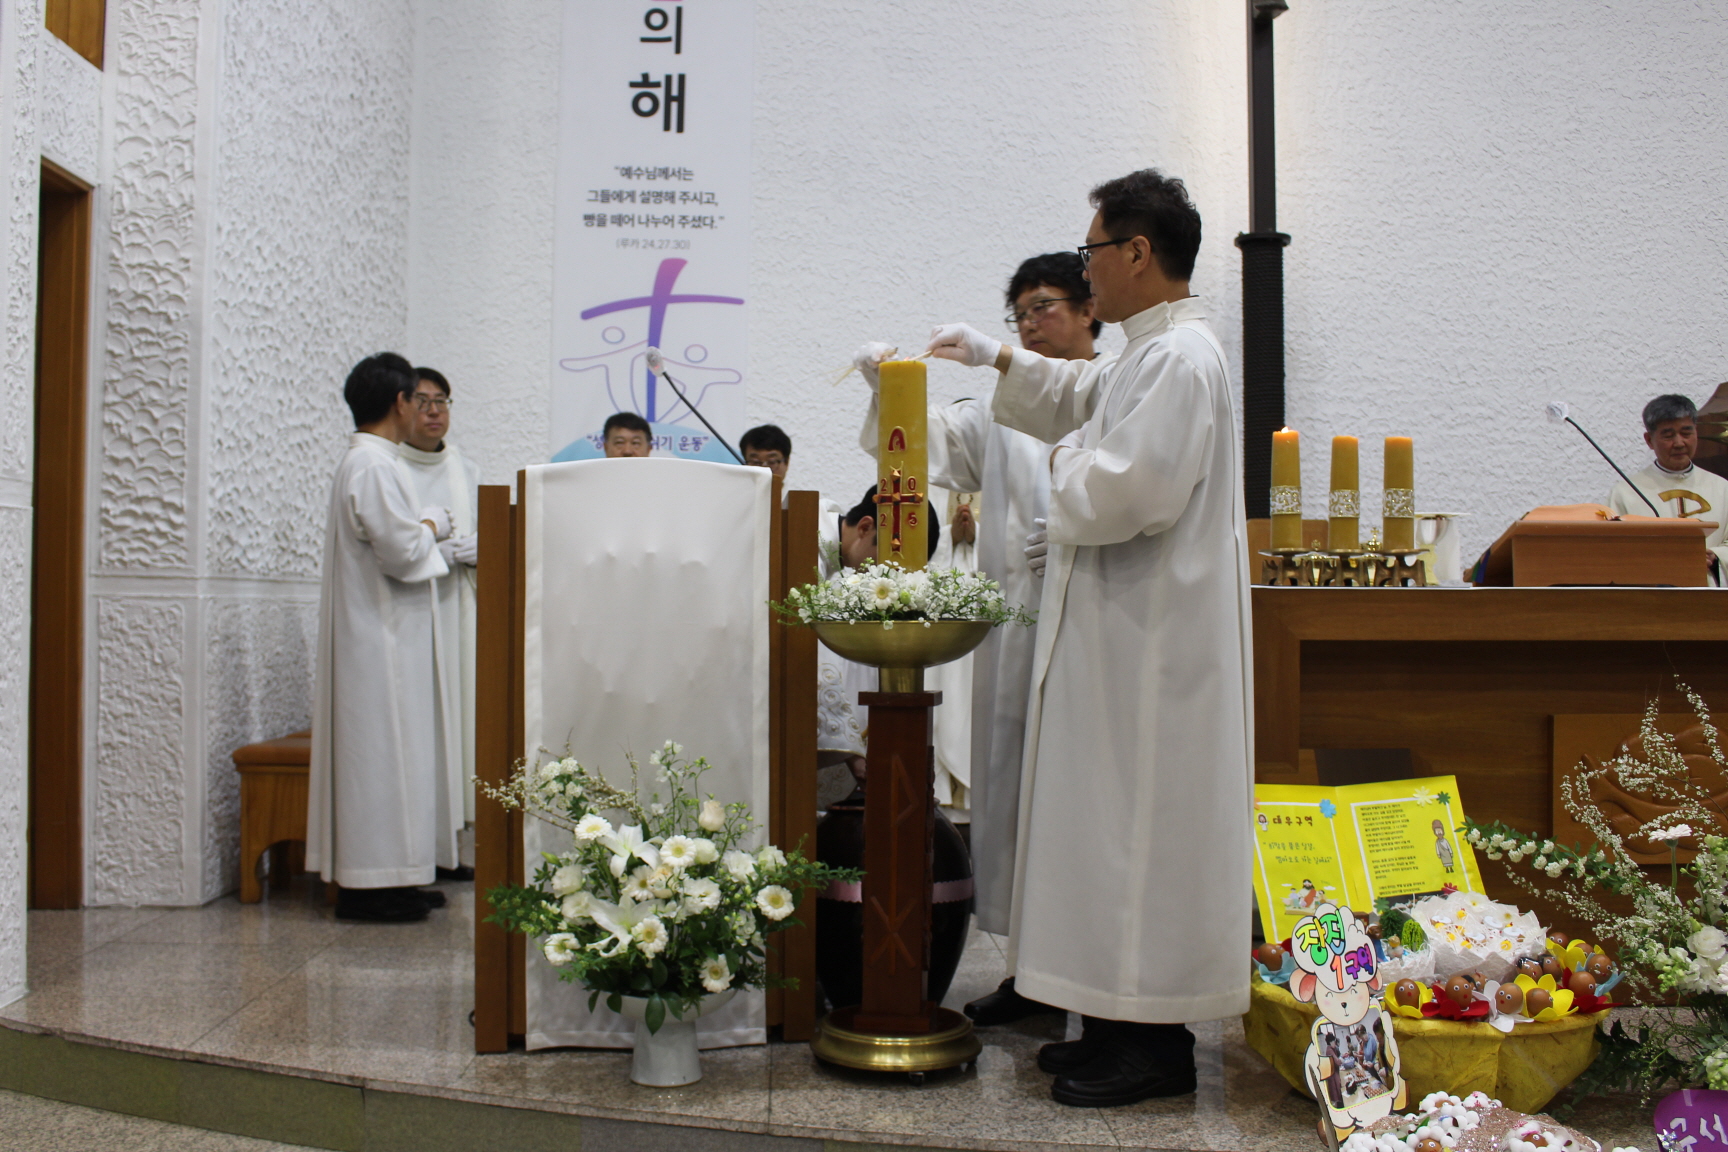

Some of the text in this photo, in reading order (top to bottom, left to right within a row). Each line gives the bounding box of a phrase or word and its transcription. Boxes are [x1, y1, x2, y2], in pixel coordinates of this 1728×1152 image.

[629, 72, 686, 133] 해
[587, 189, 718, 206] 그들에게 설명해 주시고,
[582, 213, 607, 228] 빵을
[610, 213, 635, 228] 떼어
[637, 214, 675, 228] 나누어
[616, 238, 640, 249] (루카
